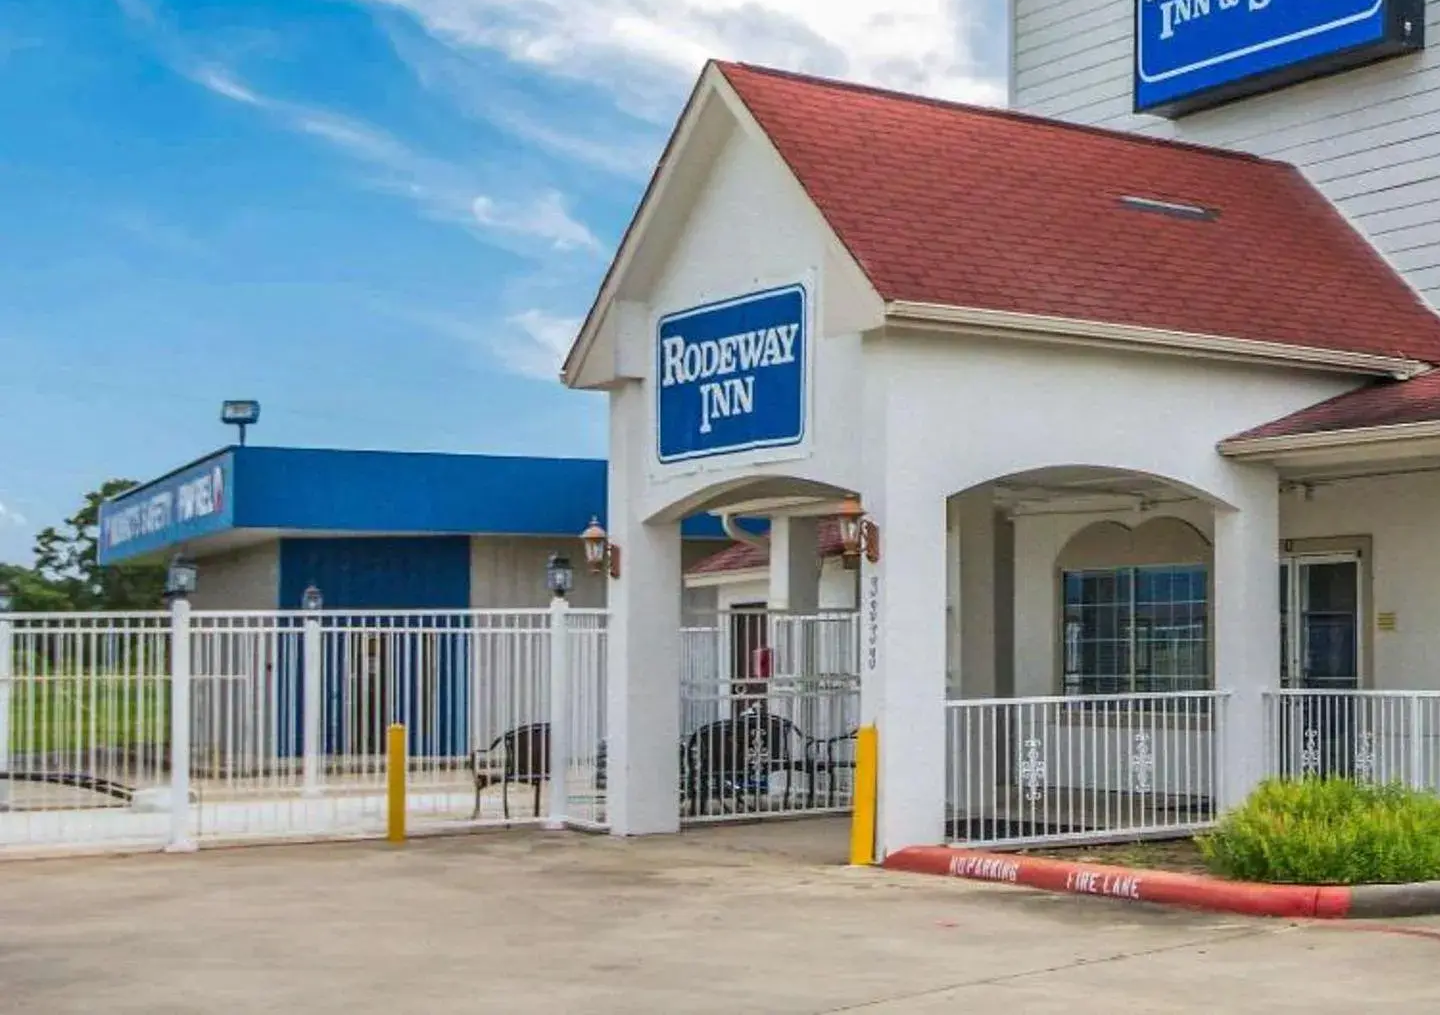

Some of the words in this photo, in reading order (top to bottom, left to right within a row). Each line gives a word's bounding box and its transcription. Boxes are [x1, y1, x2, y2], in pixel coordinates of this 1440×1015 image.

[662, 323, 800, 388] RODEWAY
[699, 376, 755, 434] INN
[965, 857, 1020, 881] PARKING
[1103, 875, 1142, 899] LANE
